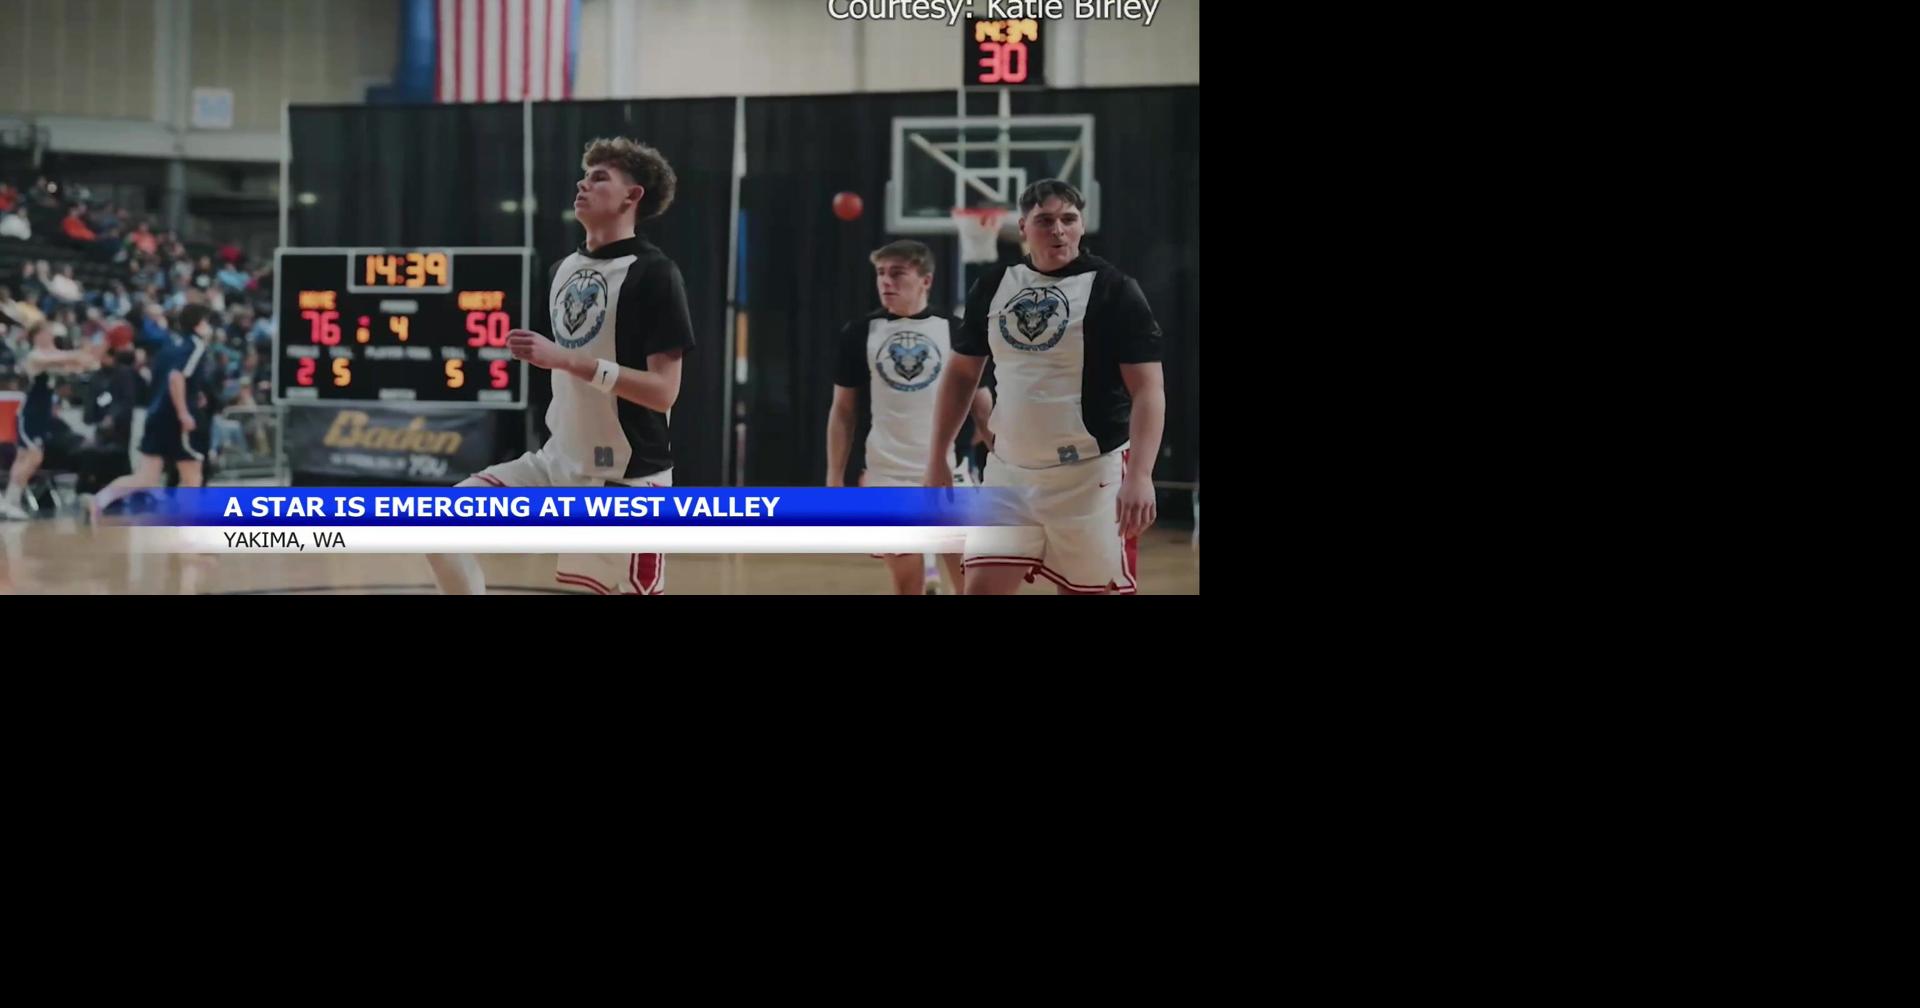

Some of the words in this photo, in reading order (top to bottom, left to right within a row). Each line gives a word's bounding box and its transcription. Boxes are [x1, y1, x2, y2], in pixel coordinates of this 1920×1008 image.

[978, 42, 1027, 83] 30
[366, 252, 447, 287] 14:39
[301, 310, 341, 346] 76
[389, 316, 409, 341] 4
[466, 311, 510, 347] 50
[296, 357, 316, 386] 2
[332, 357, 351, 386] 5
[445, 359, 464, 388] 5
[489, 360, 509, 388] 5
[323, 409, 463, 454] Baden
